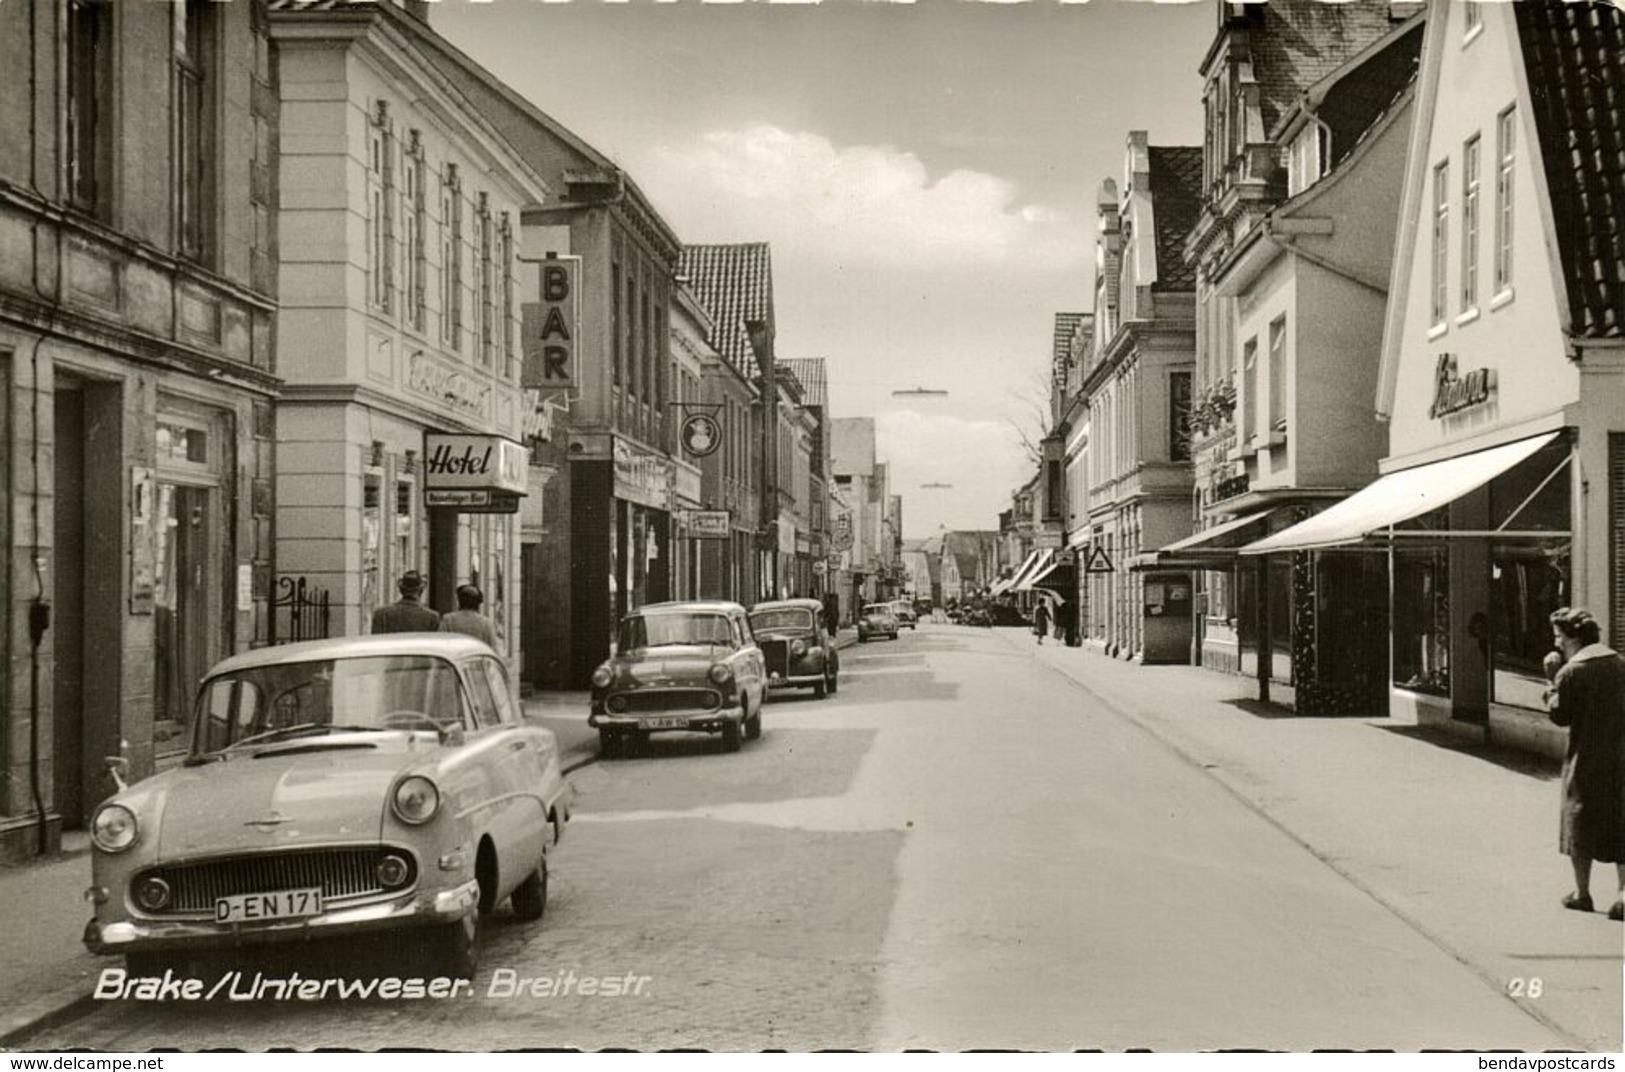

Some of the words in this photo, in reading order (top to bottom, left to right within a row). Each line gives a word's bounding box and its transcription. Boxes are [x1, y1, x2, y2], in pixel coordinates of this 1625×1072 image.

[541, 265, 570, 379] BAR
[428, 445, 493, 475] Hotel
[217, 895, 278, 920] D-EN
[287, 892, 319, 914] 171
